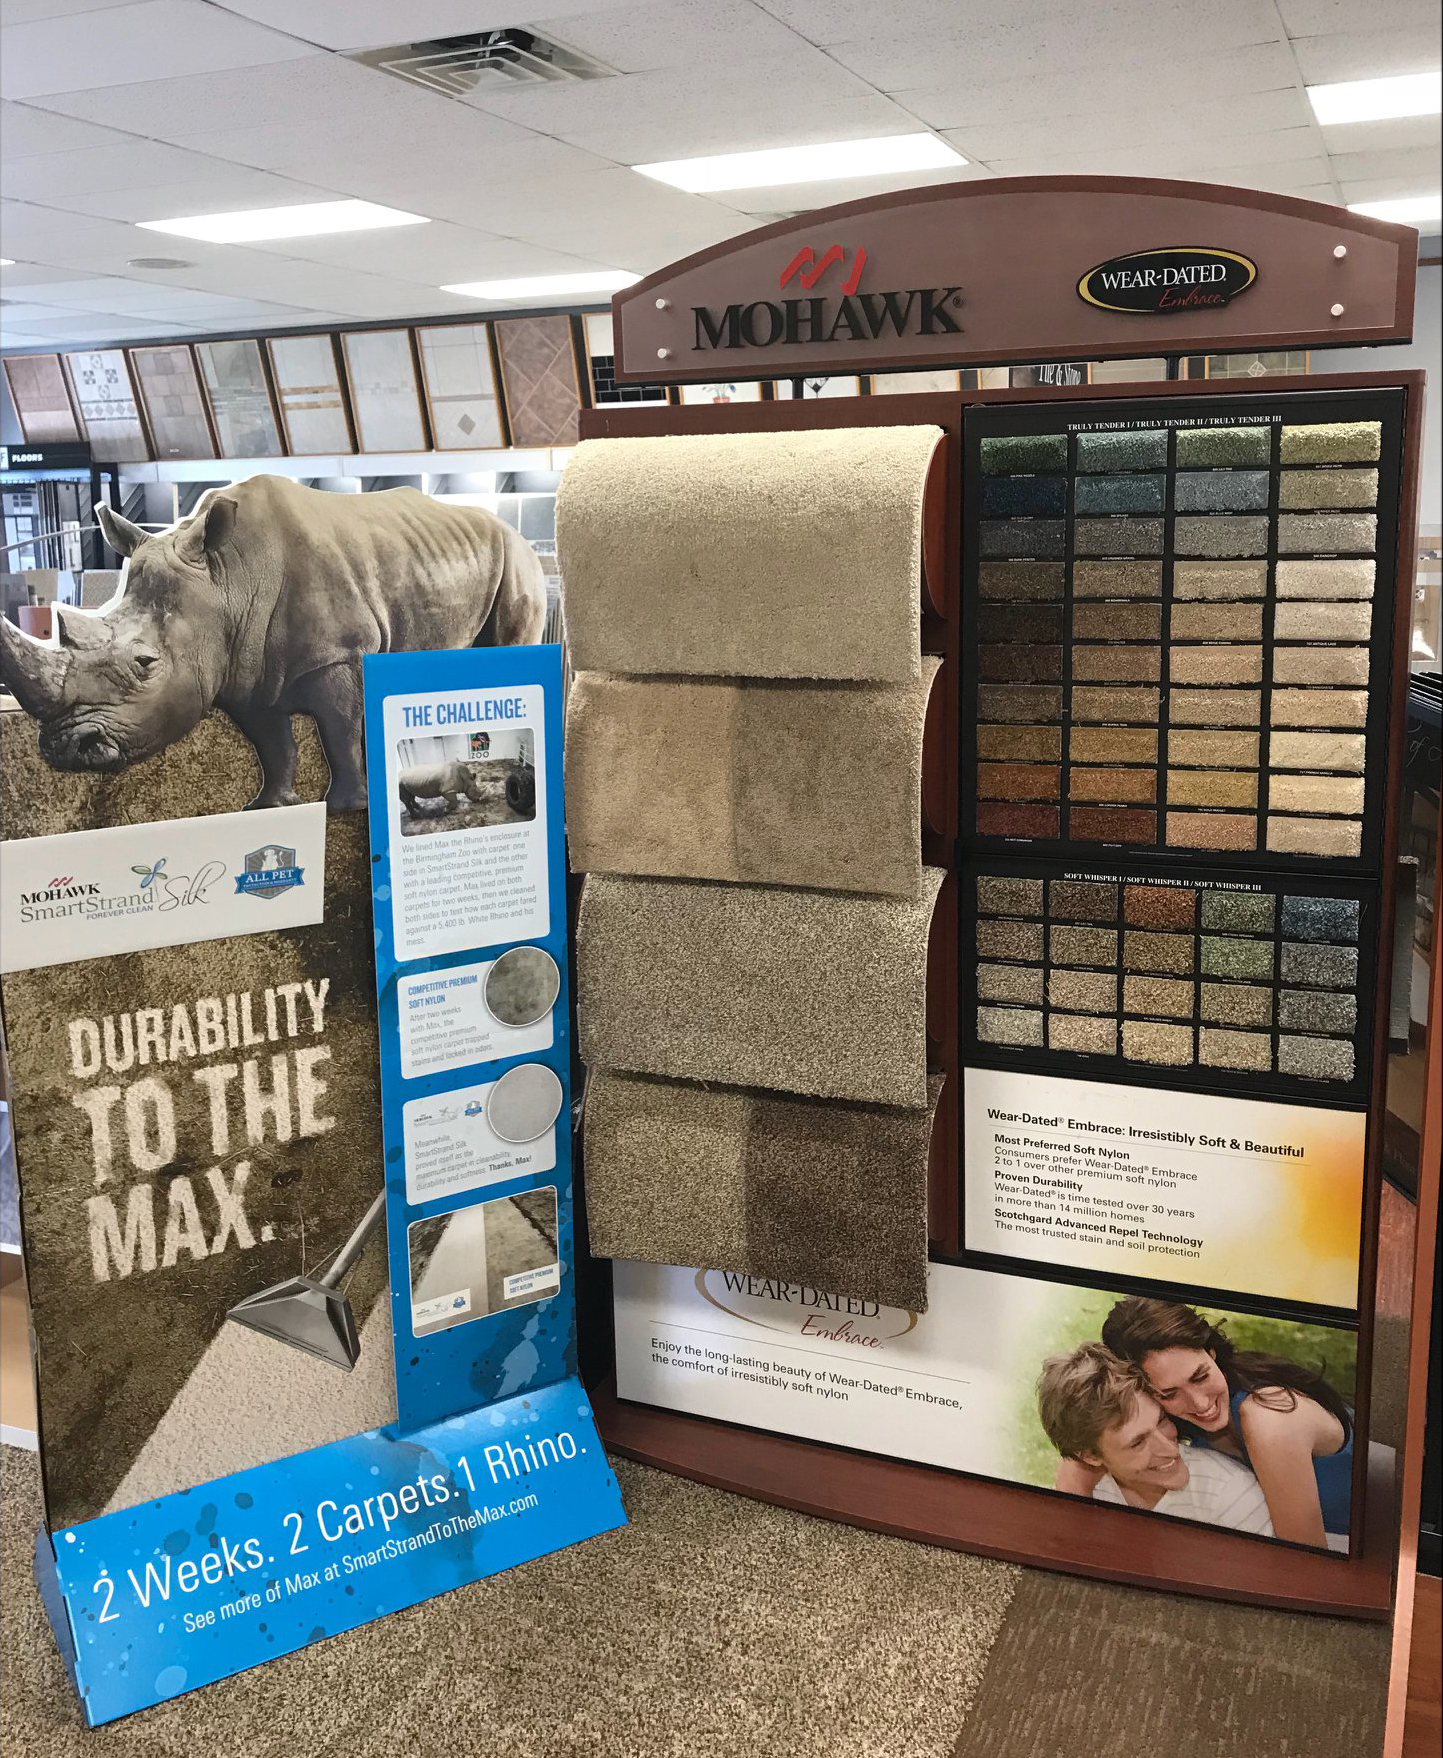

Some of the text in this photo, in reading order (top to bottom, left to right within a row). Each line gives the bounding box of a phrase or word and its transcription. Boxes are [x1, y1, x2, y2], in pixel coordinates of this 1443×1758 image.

[1158, 286, 1222, 308] Embrace
[1067, 423, 1093, 431] TRULY
[1094, 422, 1125, 430] TENDER
[1136, 420, 1162, 428] TRULY
[12, 453, 43, 463] FLOORS
[402, 698, 527, 728] THE CHALLENGE:
[471, 750, 490, 759] ZOO
[246, 873, 269, 884] ALL
[272, 869, 294, 880] PET
[1084, 874, 1118, 882] WHISPER
[1148, 878, 1182, 886] WHISPER
[1216, 882, 1251, 890] WHISPER
[20, 882, 101, 906] MOHAWK
[21, 861, 227, 923] SmartStrand Silk
[86, 904, 154, 920] FOREVER CLEAN
[408, 975, 478, 996] COMPETITIVE PREMIUM
[409, 994, 446, 1009] SOFT NYLON
[68, 978, 331, 1079] DURABILITY
[73, 1045, 336, 1185] TO THE
[995, 1134, 1130, 1160] Most Preferred Soft Nylon
[1068, 1119, 1125, 1136] Embrace:
[1129, 1126, 1195, 1146] Irresistibly
[1199, 1135, 1226, 1148] Soft
[1230, 1139, 1240, 1150] &
[1245, 1140, 1304, 1158] Beautiful
[489, 1154, 532, 1172] Thanks, Max!
[995, 1147, 1050, 1161] Consumers
[1053, 1156, 1082, 1165] prefer
[1152, 1167, 1198, 1181] Embrace
[995, 1156, 1176, 1188] 2 to 1 over other premium soft nylon
[995, 1171, 1083, 1192] Proven Durability
[995, 1194, 1145, 1223] in more than 14 million homes
[1058, 1191, 1066, 1200] is
[1068, 1194, 1090, 1204] time
[1093, 1197, 1123, 1208] tested
[1126, 1203, 1149, 1212] over
[1152, 1205, 1164, 1214] 30
[1167, 1209, 1195, 1218] years
[84, 1160, 277, 1283] MAX.
[995, 1209, 1204, 1248] Scotchgard Advanced Repel Technology
[994, 1220, 1200, 1258] The most trusted stain and soil protection
[800, 1314, 882, 1349] Embrace
[652, 1338, 682, 1354] Enjoy
[684, 1345, 702, 1357] the
[705, 1348, 770, 1372] long-lasting
[773, 1362, 812, 1380] beauty
[815, 1372, 826, 1381] of
[906, 1388, 963, 1410] Embrace,
[652, 1354, 848, 1401] the comfort of irresistibly soft nylon
[93, 1432, 587, 1624] 2 Weeks. 2 Carpets. 1 Rhino.
[183, 1493, 539, 1633] See more of Max at SmartStrandToTheMax.com
